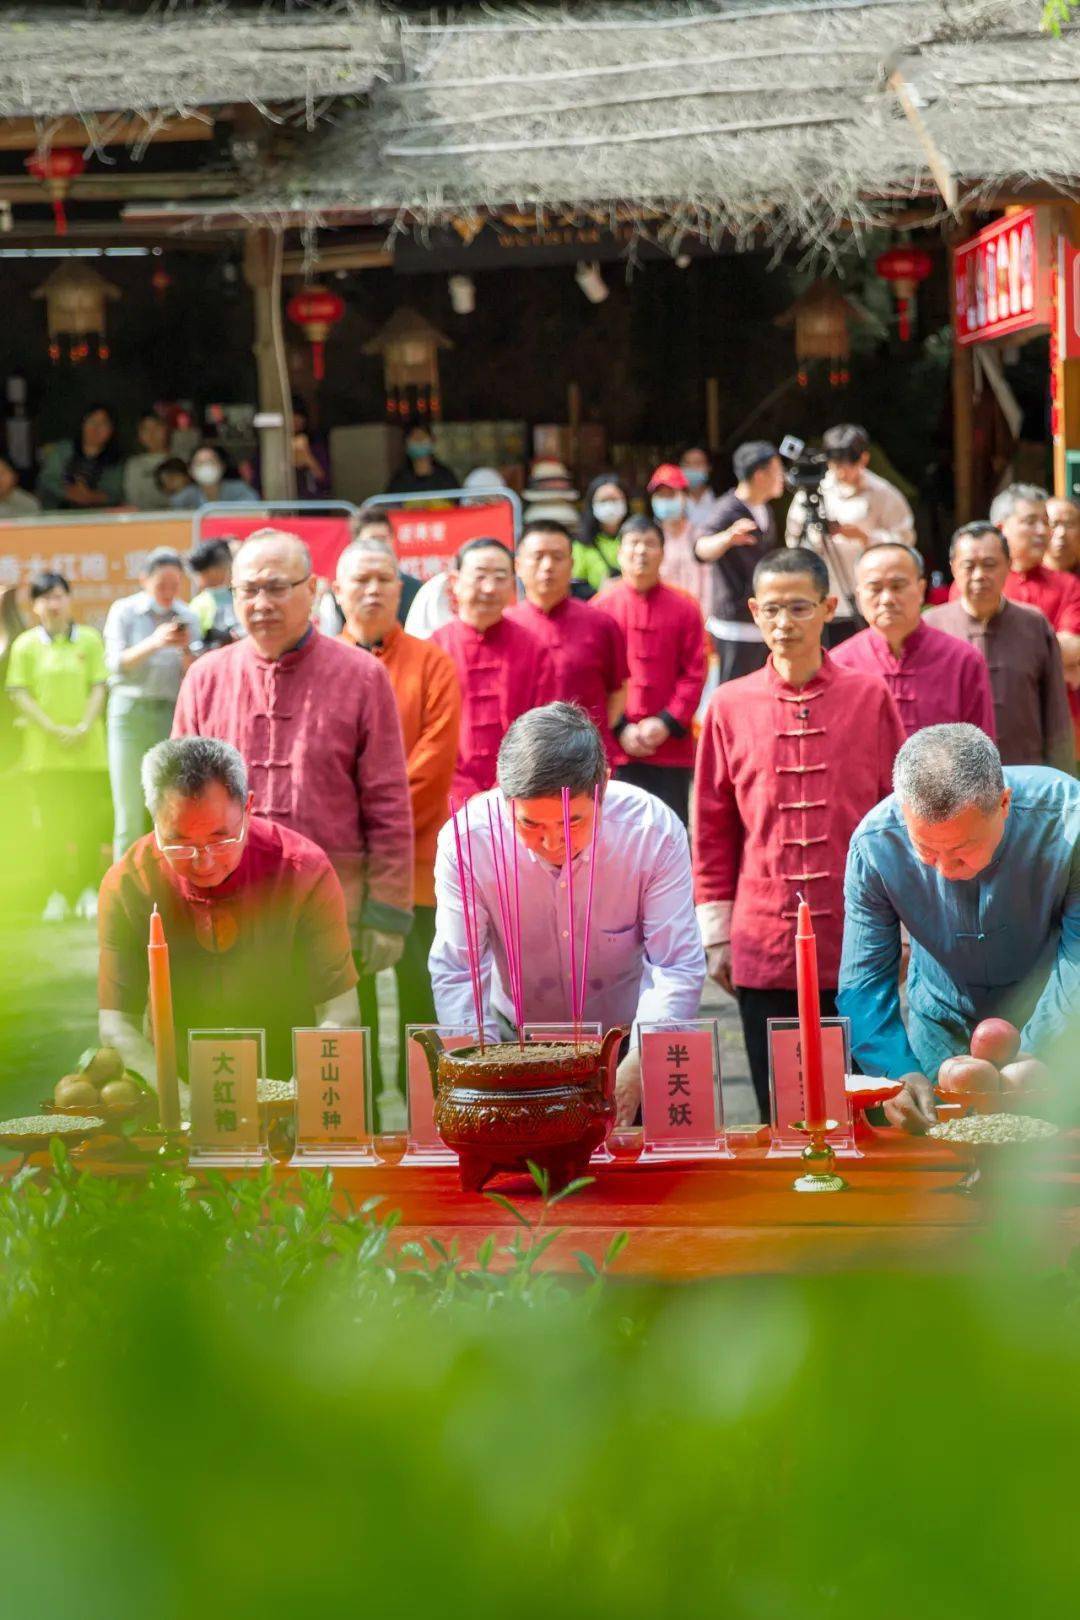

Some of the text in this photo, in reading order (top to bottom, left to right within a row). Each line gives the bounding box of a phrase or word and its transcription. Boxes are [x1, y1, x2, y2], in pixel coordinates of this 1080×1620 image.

[212, 1051, 237, 1132] 大红袍
[320, 1038, 341, 1130] 正山小种
[666, 1044, 692, 1126] 半天妖
